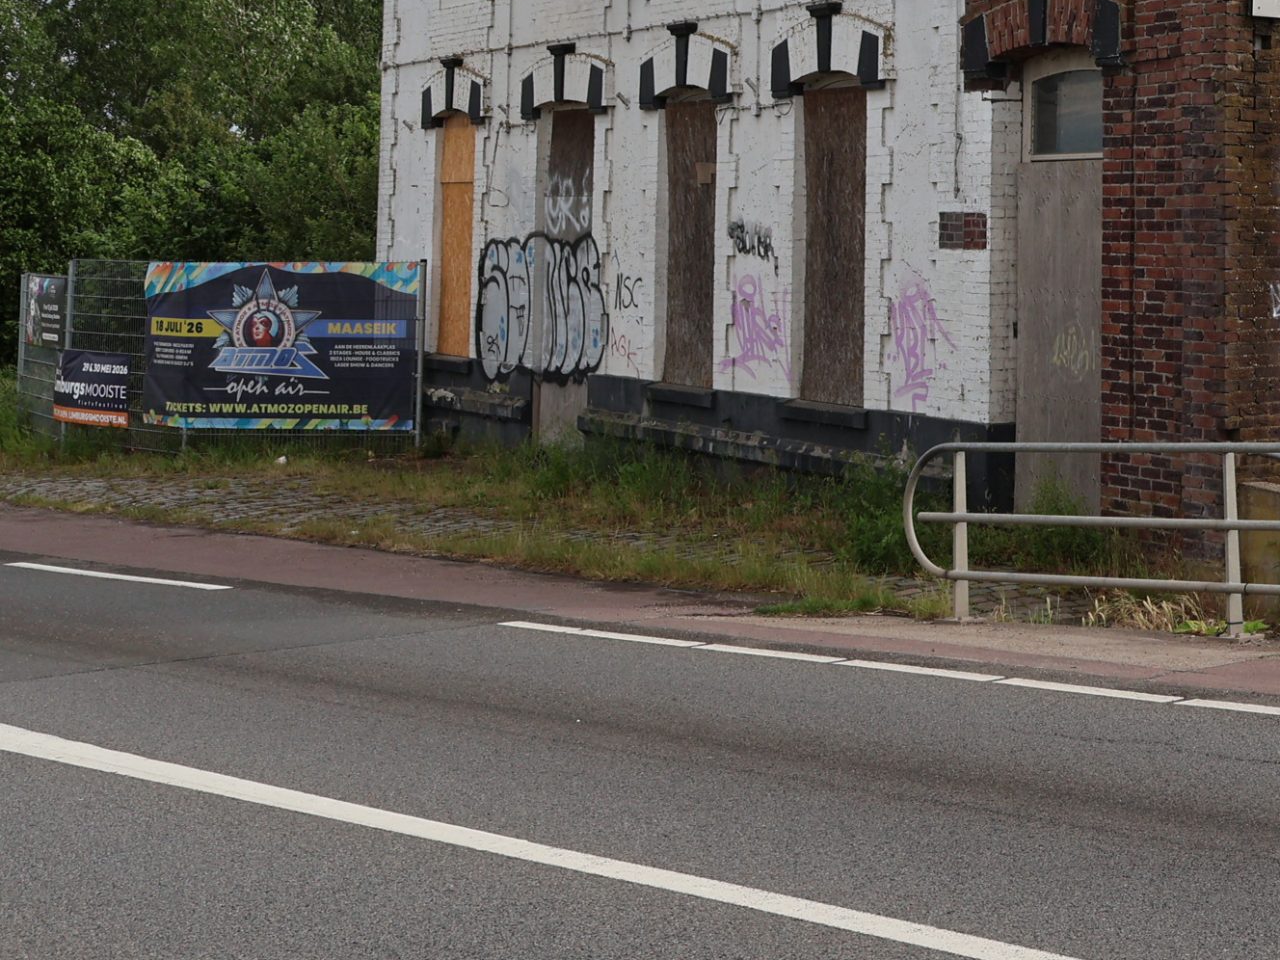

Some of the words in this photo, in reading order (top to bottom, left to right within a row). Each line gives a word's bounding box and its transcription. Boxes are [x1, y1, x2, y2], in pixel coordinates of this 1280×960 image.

[156, 321, 164, 332] 18
[165, 321, 182, 333] JULI
[327, 322, 397, 335] MAASEIK
[112, 365, 128, 375] 2026
[226, 378, 269, 402] open
[165, 401, 206, 413] TICKETS:
[209, 403, 369, 415] WWW.ATMOZOPENAIR.BE
